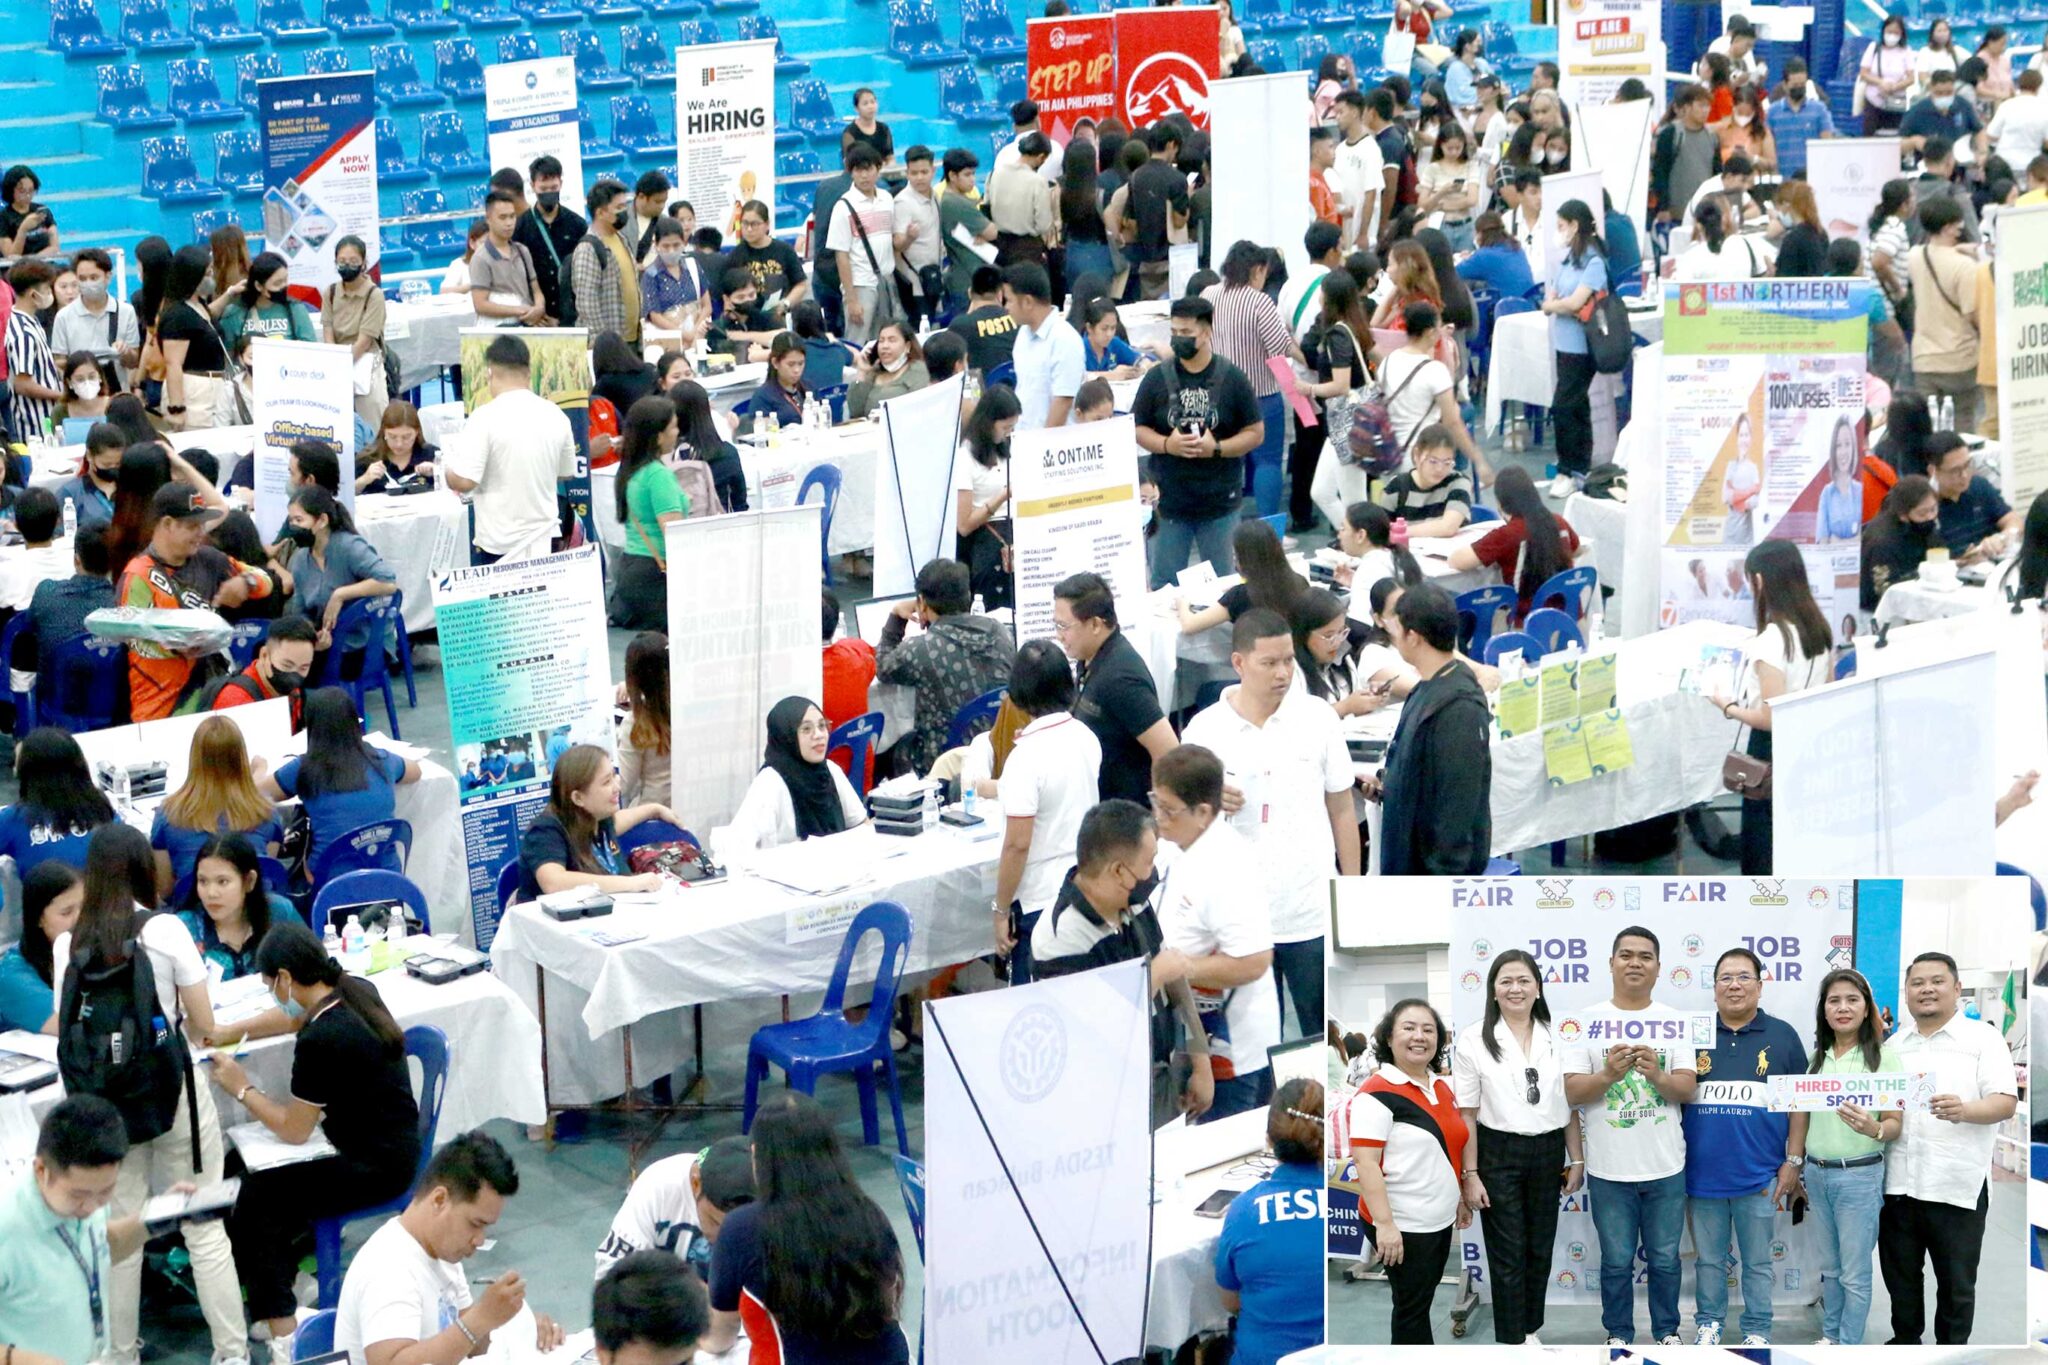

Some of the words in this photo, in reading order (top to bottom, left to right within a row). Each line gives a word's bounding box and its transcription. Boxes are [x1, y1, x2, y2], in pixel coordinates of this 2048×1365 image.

[1579, 21, 1598, 37] WE
[1600, 19, 1622, 35] ARE
[1030, 60, 1082, 99] STEP
[1086, 53, 1113, 84] UP
[687, 100, 705, 111] We
[708, 98, 728, 110] Are
[1051, 98, 1066, 110] AIA
[1066, 93, 1114, 109] PHILIPPINES
[510, 119, 524, 130] JOB
[524, 113, 560, 127] VACANCIES
[688, 107, 765, 135] HIRING
[268, 126, 305, 136] WINNING
[339, 155, 370, 166] APPLY
[343, 163, 371, 174] NOW!
[1712, 283, 1737, 300] 1st
[2017, 322, 2048, 350] JOB
[1769, 384, 1788, 410] 100
[1788, 392, 1831, 409] NURSES
[273, 421, 334, 440] Office-based
[453, 566, 491, 582] LEAD
[492, 562, 529, 574] RESOURCES
[530, 554, 574, 568] MANAGEMENT
[575, 550, 593, 560] CORP.
[527, 662, 558, 671] HOSPITAL
[493, 724, 537, 736] INTERNATIONAL
[1452, 886, 1513, 908] FAIR
[1663, 882, 1726, 902] FAIR
[1528, 938, 1588, 960] JOB
[1741, 936, 1801, 958] JOB
[1834, 937, 1852, 946] HOTS
[1538, 963, 1590, 983] AIR
[1760, 962, 1802, 982] AIR
[1587, 1019, 1685, 1040] #HOTS!
[1703, 1084, 1752, 1101] POLO
[1795, 1080, 1842, 1093] HIRED
[1845, 1079, 1870, 1092] ON
[1874, 1079, 1907, 1091] THE
[1826, 1094, 1873, 1107] SPOT!
[1618, 1110, 1637, 1119] SURF
[1639, 1109, 1656, 1118] SOUL
[1720, 1106, 1752, 1116] LAUREN
[1253, 1187, 1324, 1226] TES
[1329, 1224, 1358, 1237] KITS
